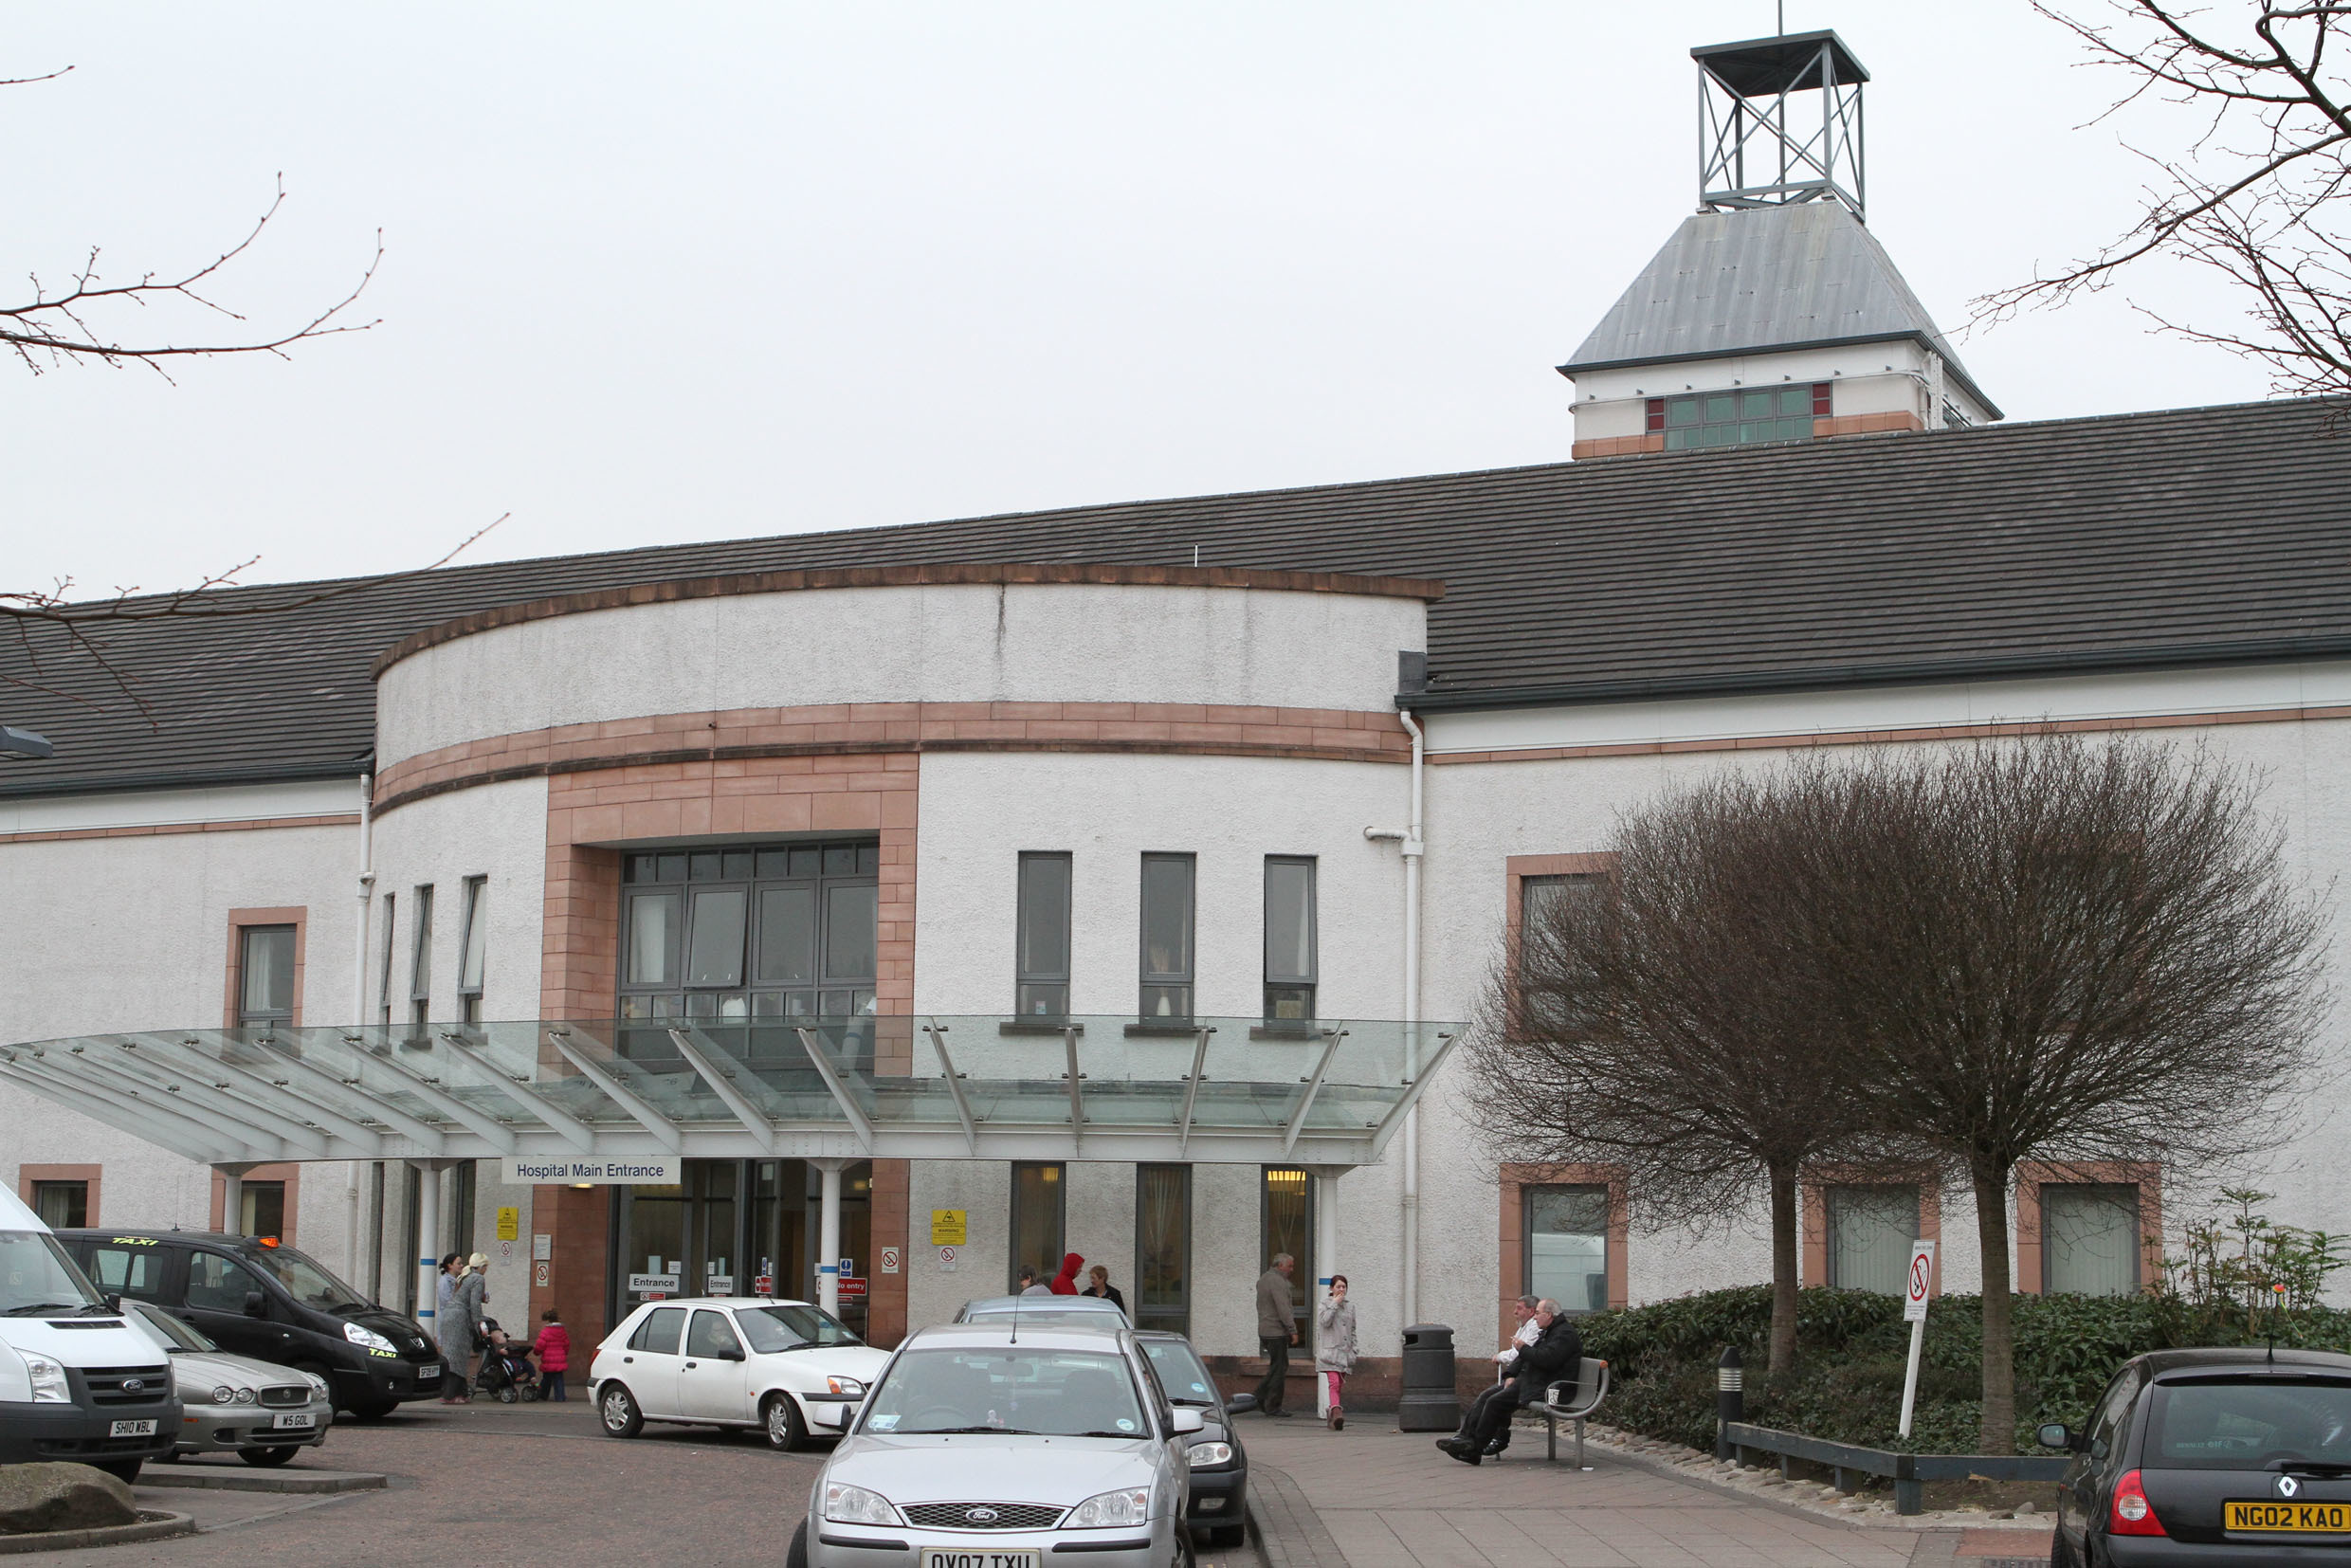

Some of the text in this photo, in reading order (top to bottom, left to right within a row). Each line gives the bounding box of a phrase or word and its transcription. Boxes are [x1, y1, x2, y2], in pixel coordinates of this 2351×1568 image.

[518, 1164, 664, 1179] Hospital Main Entrance
[112, 1237, 159, 1247] TAXI
[633, 1278, 675, 1287] Entrance
[710, 1280, 731, 1288] Entrance
[369, 1348, 397, 1358] TAXI
[295, 1414, 308, 1426] GOL
[116, 1421, 151, 1434] SH10 WBL
[973, 1511, 991, 1520] Ford
[2234, 1506, 2343, 1527] NG02 KAO
